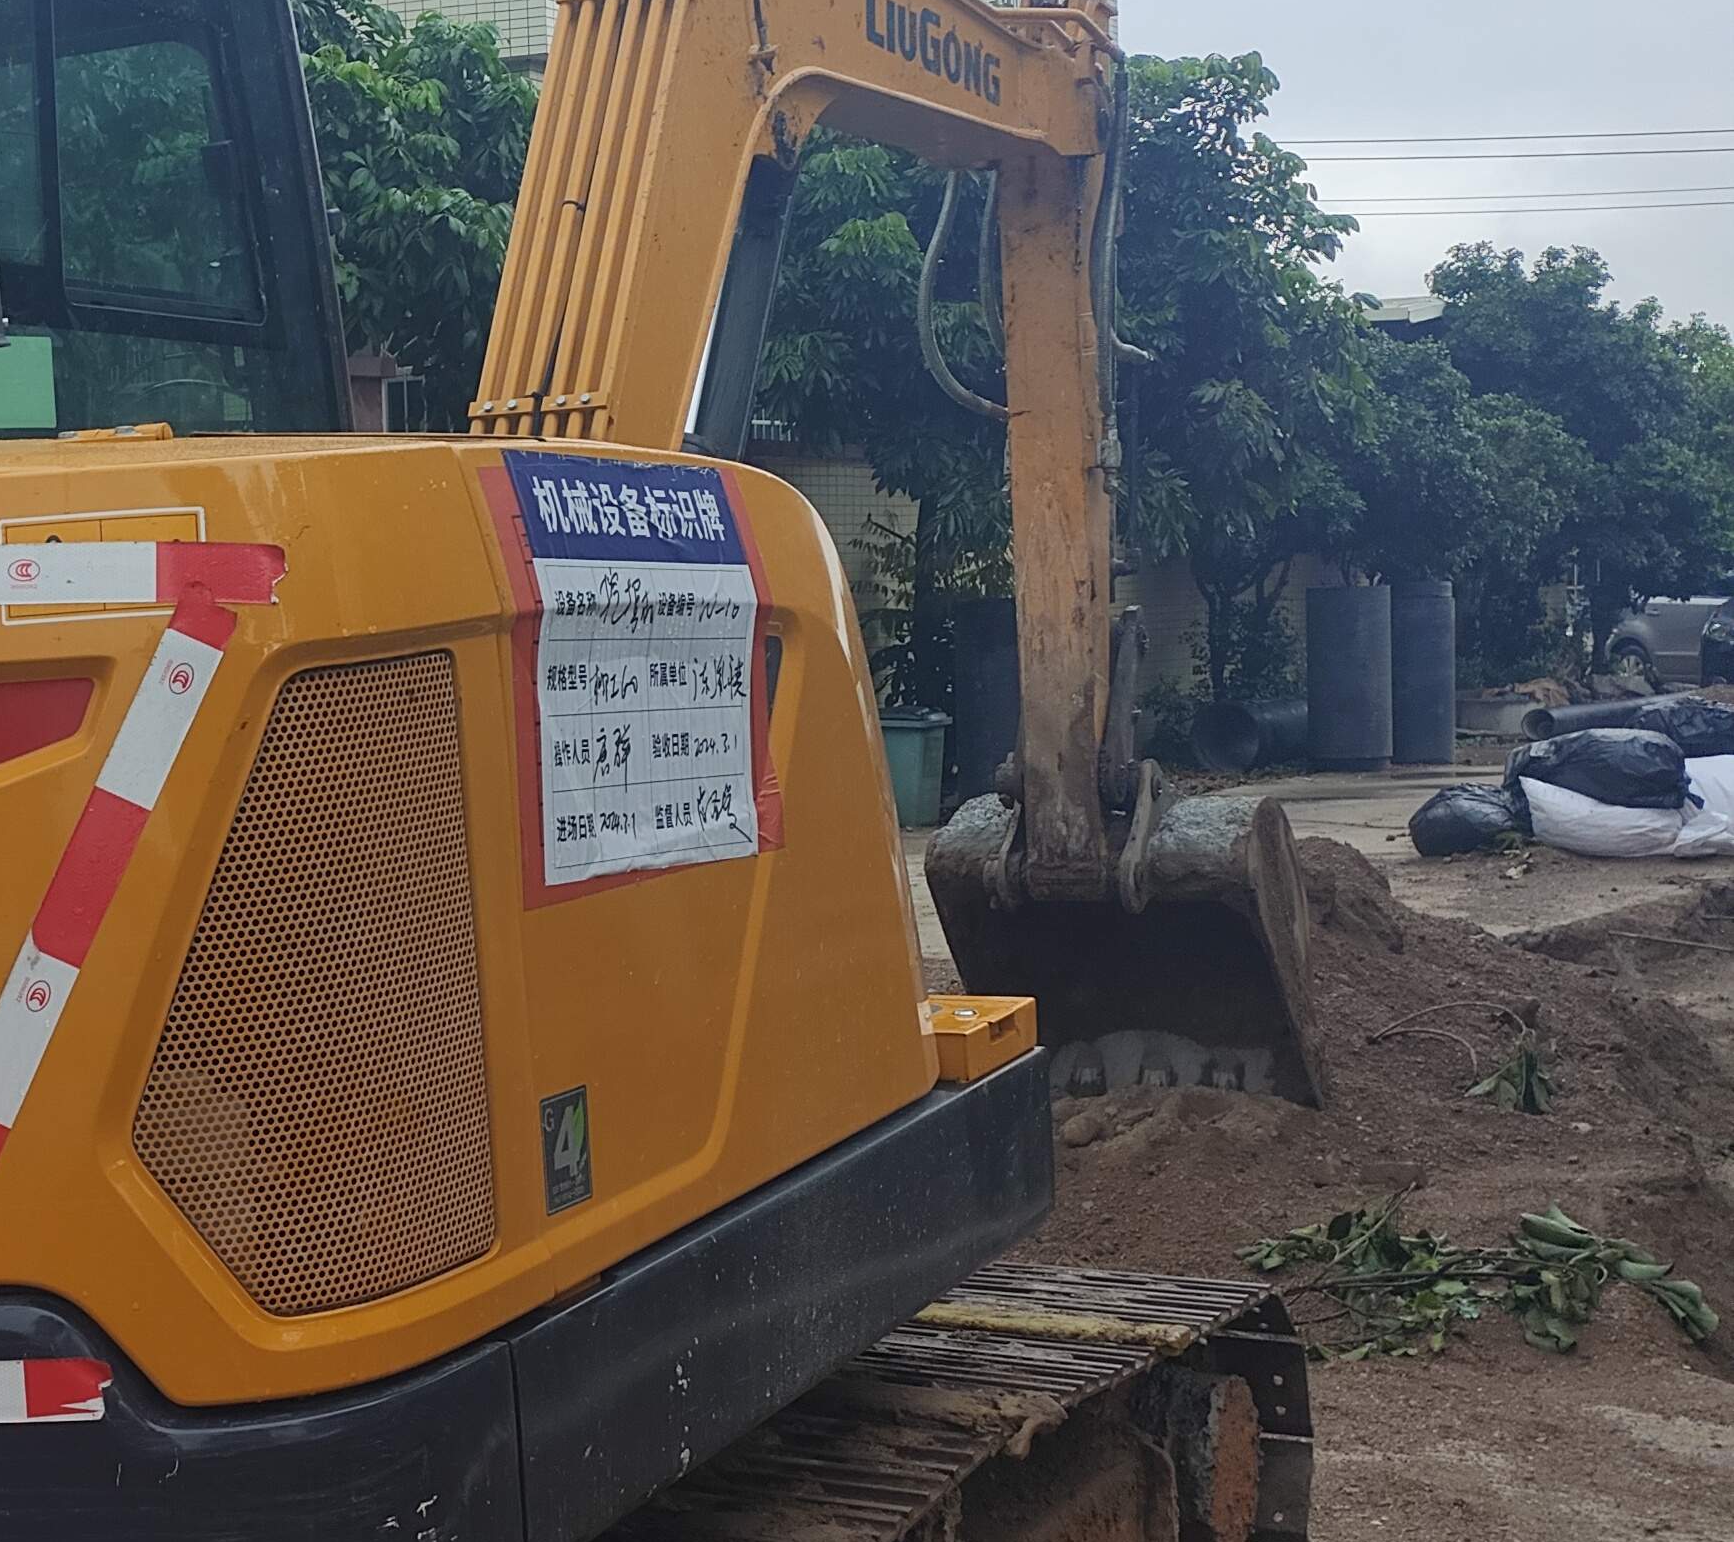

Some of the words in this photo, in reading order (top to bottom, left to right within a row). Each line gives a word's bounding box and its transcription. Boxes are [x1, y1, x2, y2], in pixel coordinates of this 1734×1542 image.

[532, 475, 725, 541] 机械设备标识牌
[555, 590, 596, 616] 设备名称
[657, 592, 695, 616] 设备编号
[546, 663, 588, 691] 规格型号
[649, 662, 687, 687] 所属单位
[554, 739, 591, 767] 操作人员
[652, 732, 690, 759] 验收日期
[556, 812, 597, 842] 进场日期
[655, 802, 694, 830] 监督人员
